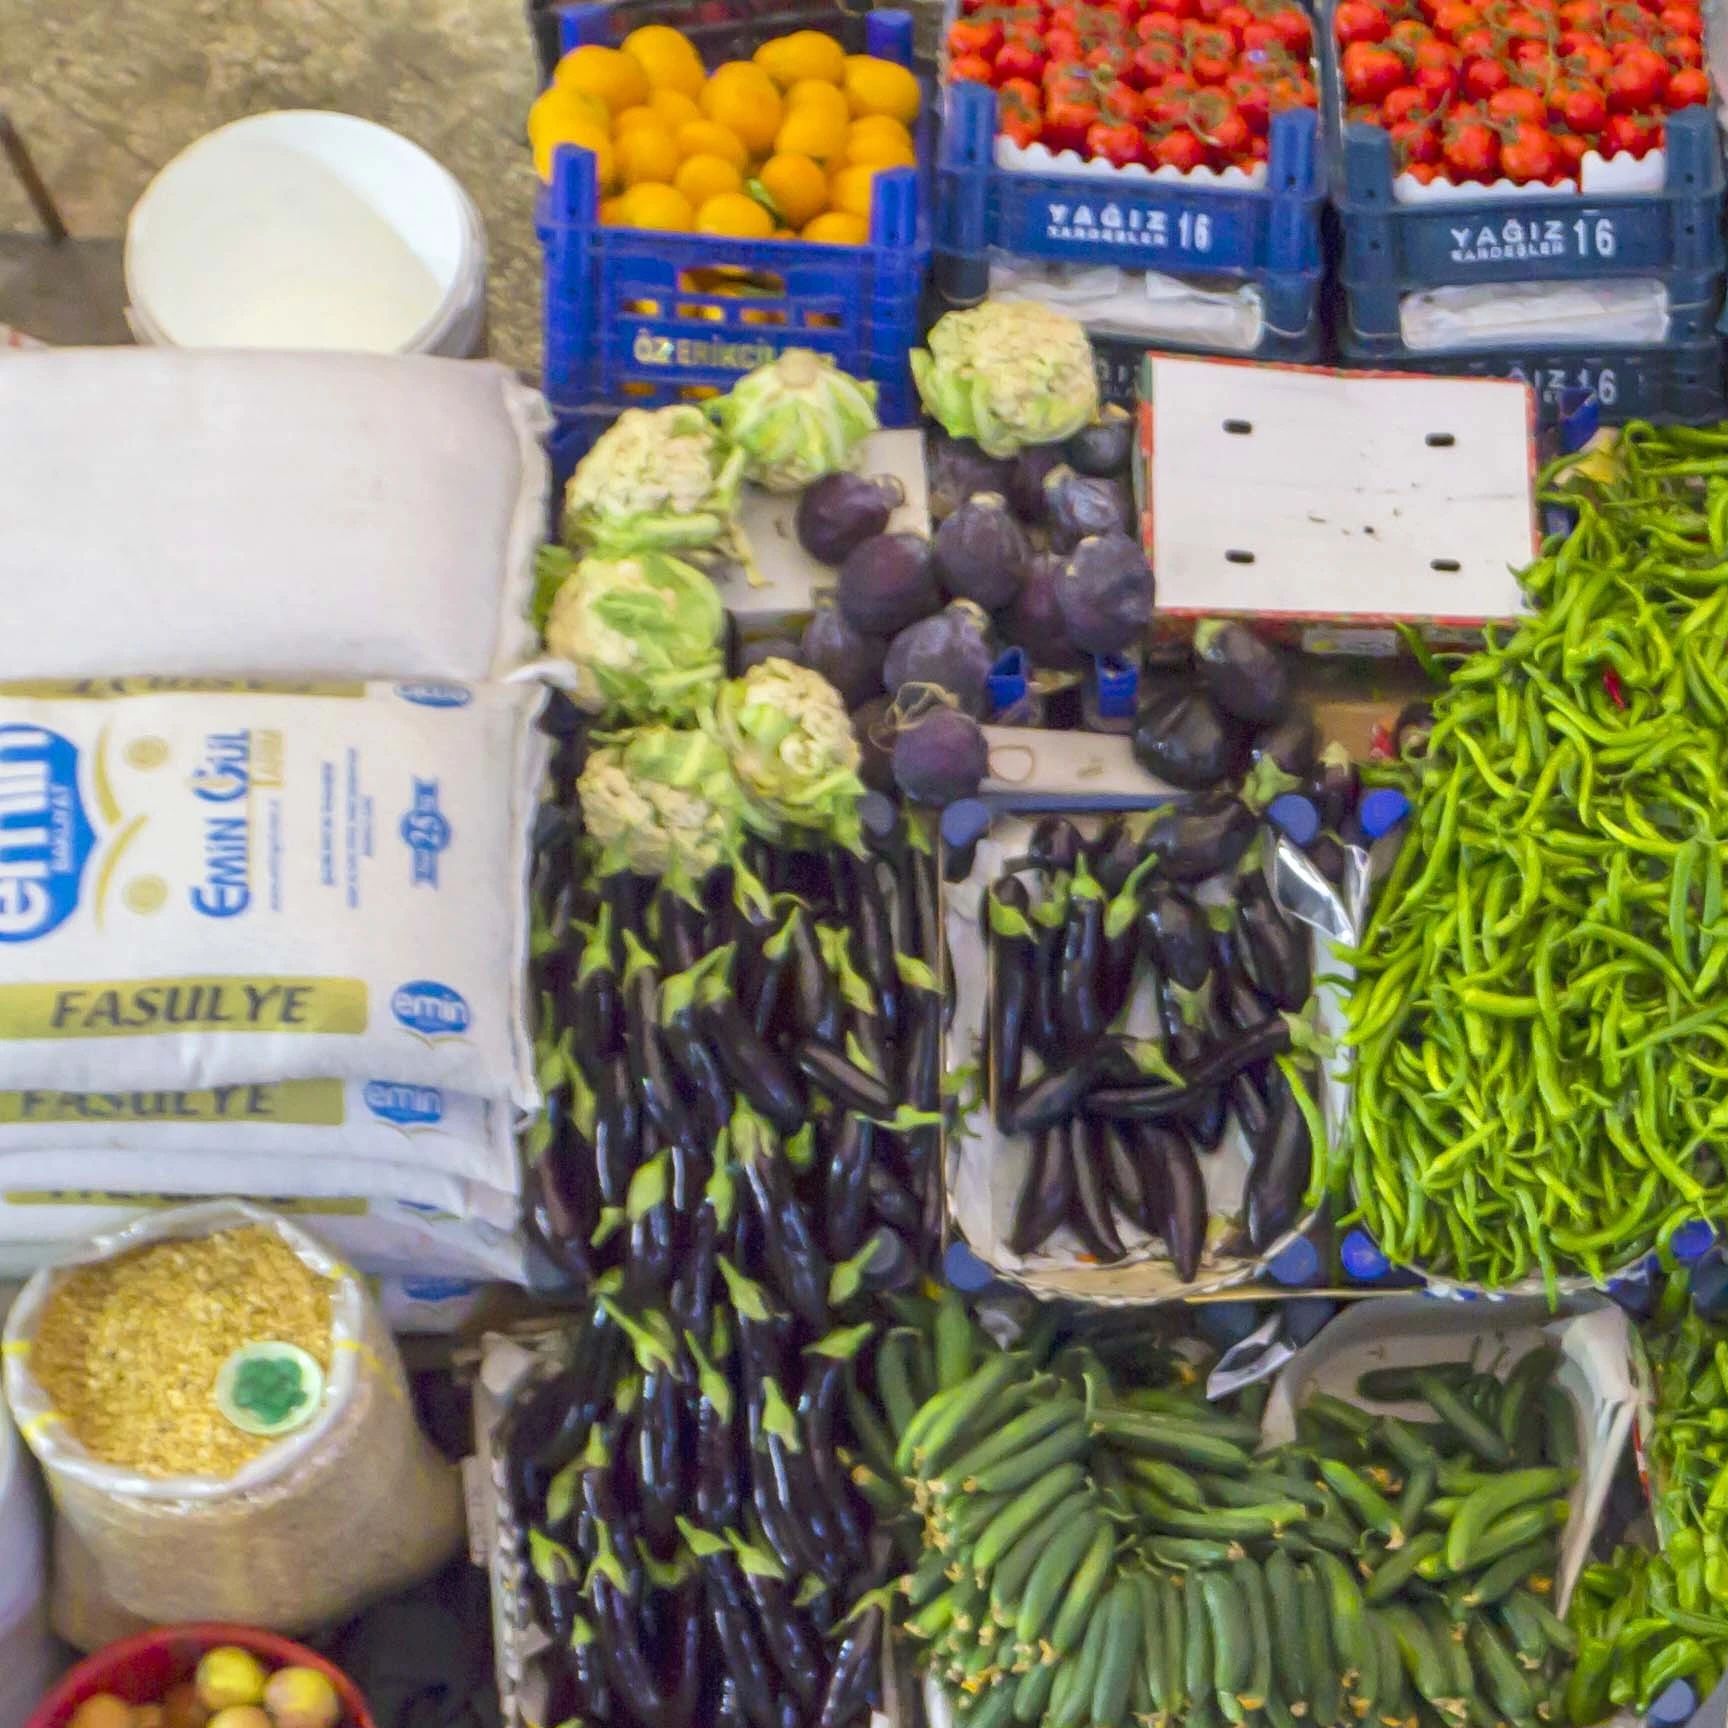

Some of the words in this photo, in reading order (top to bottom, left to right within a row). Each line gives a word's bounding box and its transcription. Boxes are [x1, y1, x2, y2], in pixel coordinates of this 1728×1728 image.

[1178, 210, 1212, 252] 16
[1573, 218, 1617, 258] 16
[50, 983, 313, 1030] FASULYE
